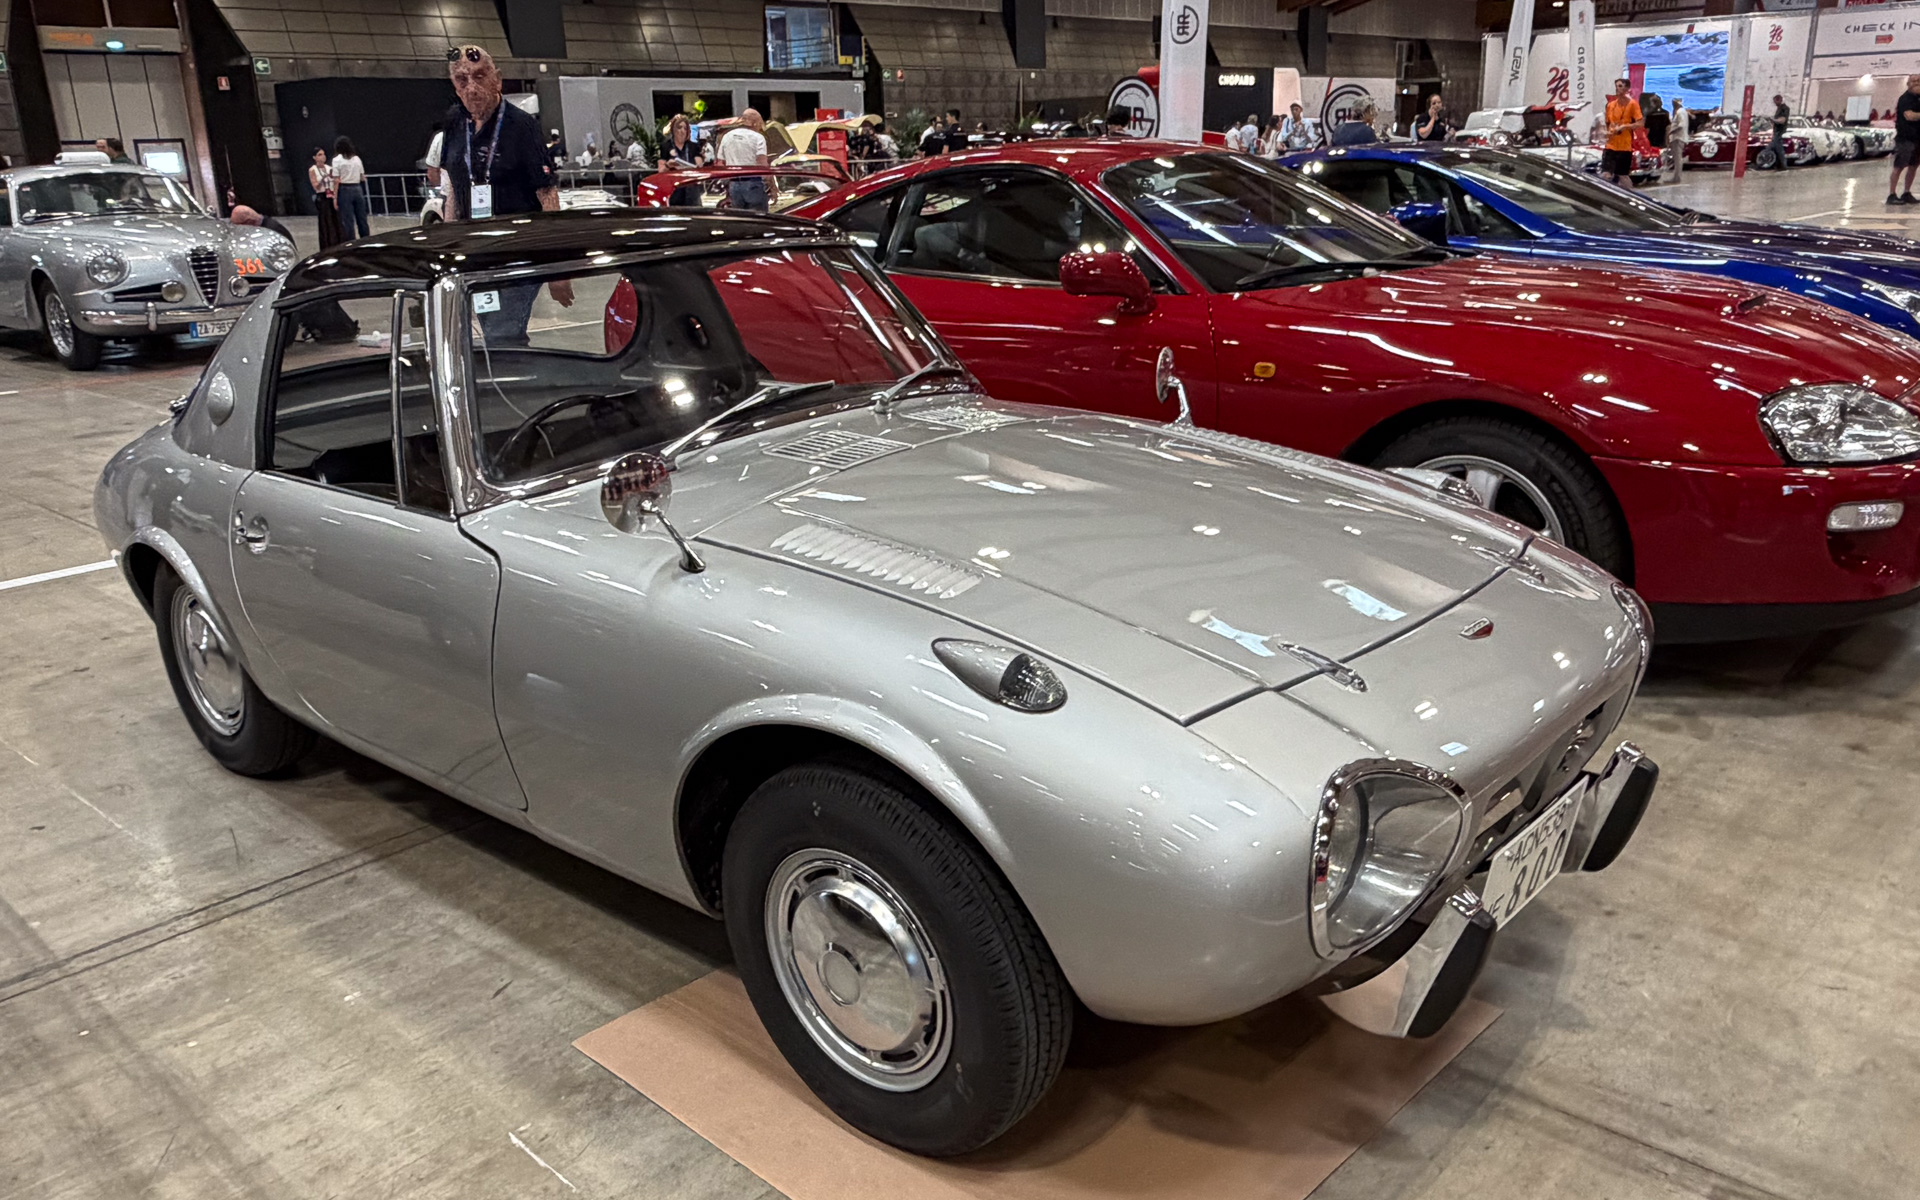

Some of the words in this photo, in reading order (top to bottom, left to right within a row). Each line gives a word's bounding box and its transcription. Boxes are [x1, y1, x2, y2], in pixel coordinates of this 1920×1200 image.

[1845, 22, 1895, 33] CHECK
[484, 293, 494, 304] 3
[1505, 829, 1567, 918] 800
